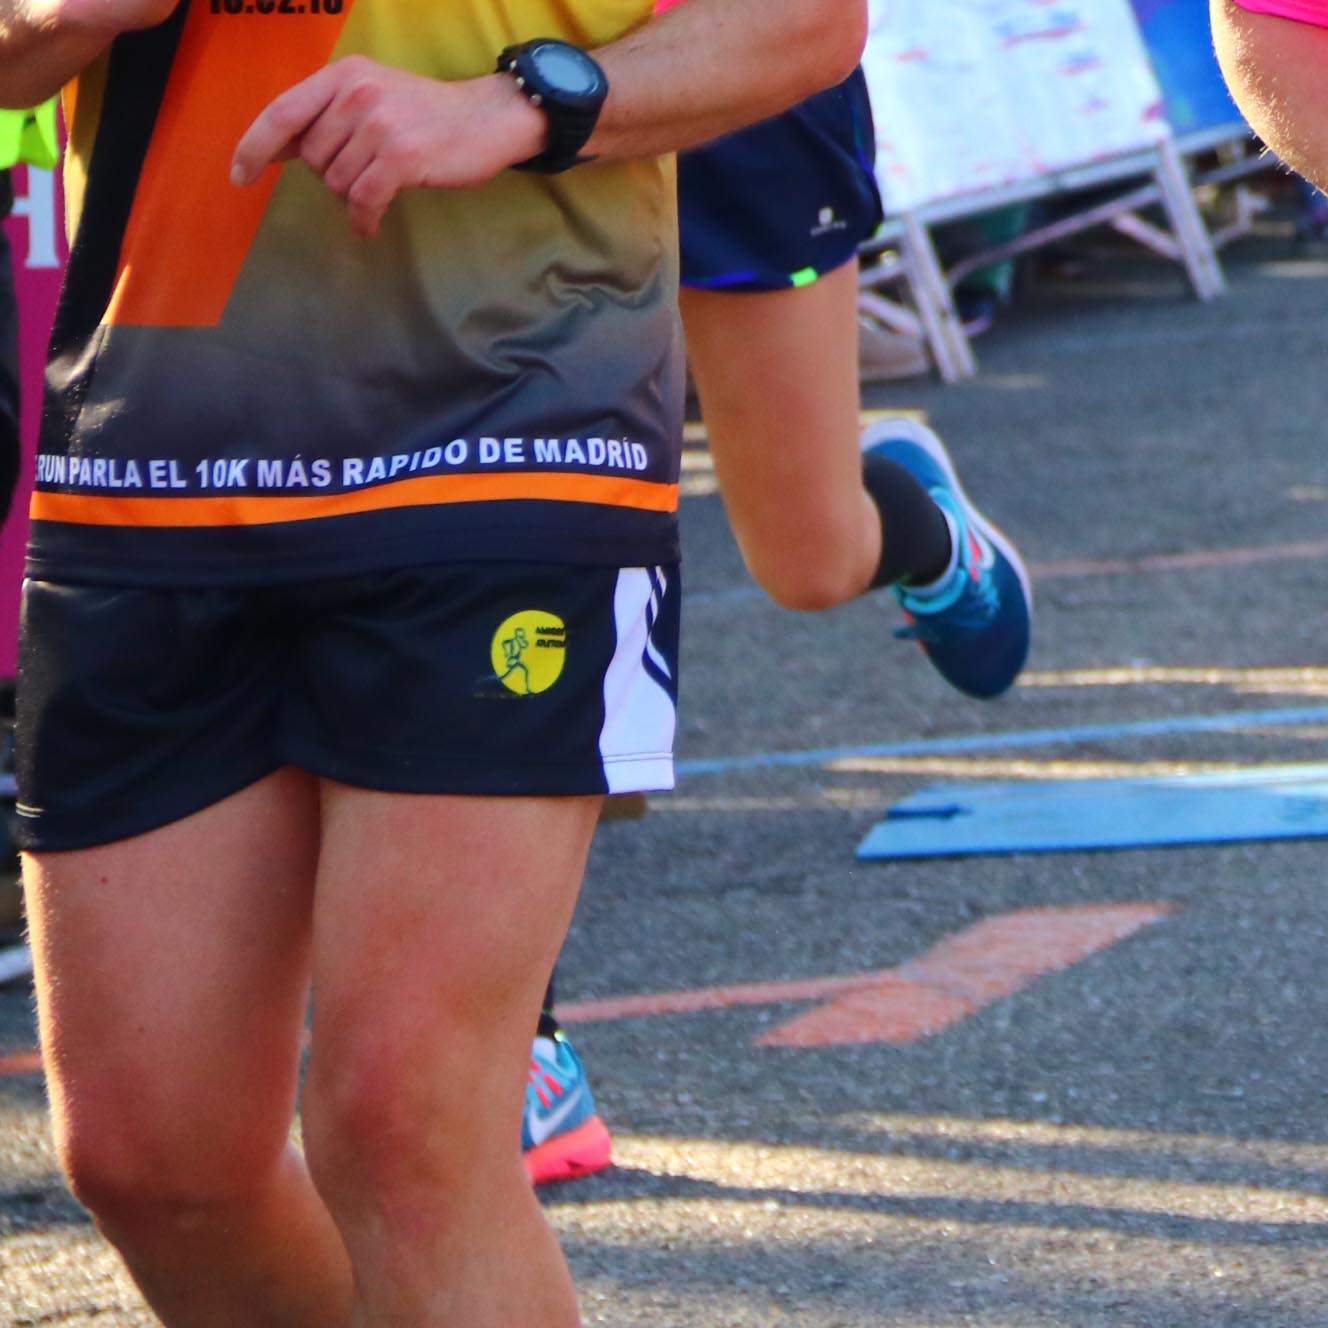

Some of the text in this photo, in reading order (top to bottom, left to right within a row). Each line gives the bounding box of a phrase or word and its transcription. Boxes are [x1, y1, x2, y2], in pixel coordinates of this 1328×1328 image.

[68, 456, 143, 488] PARLA
[150, 460, 187, 488] EL
[195, 459, 249, 488] 10K
[257, 454, 333, 488] MÁS
[342, 438, 468, 486] RAPIDO
[479, 437, 525, 464] DE
[533, 436, 648, 471] MADRÍD
